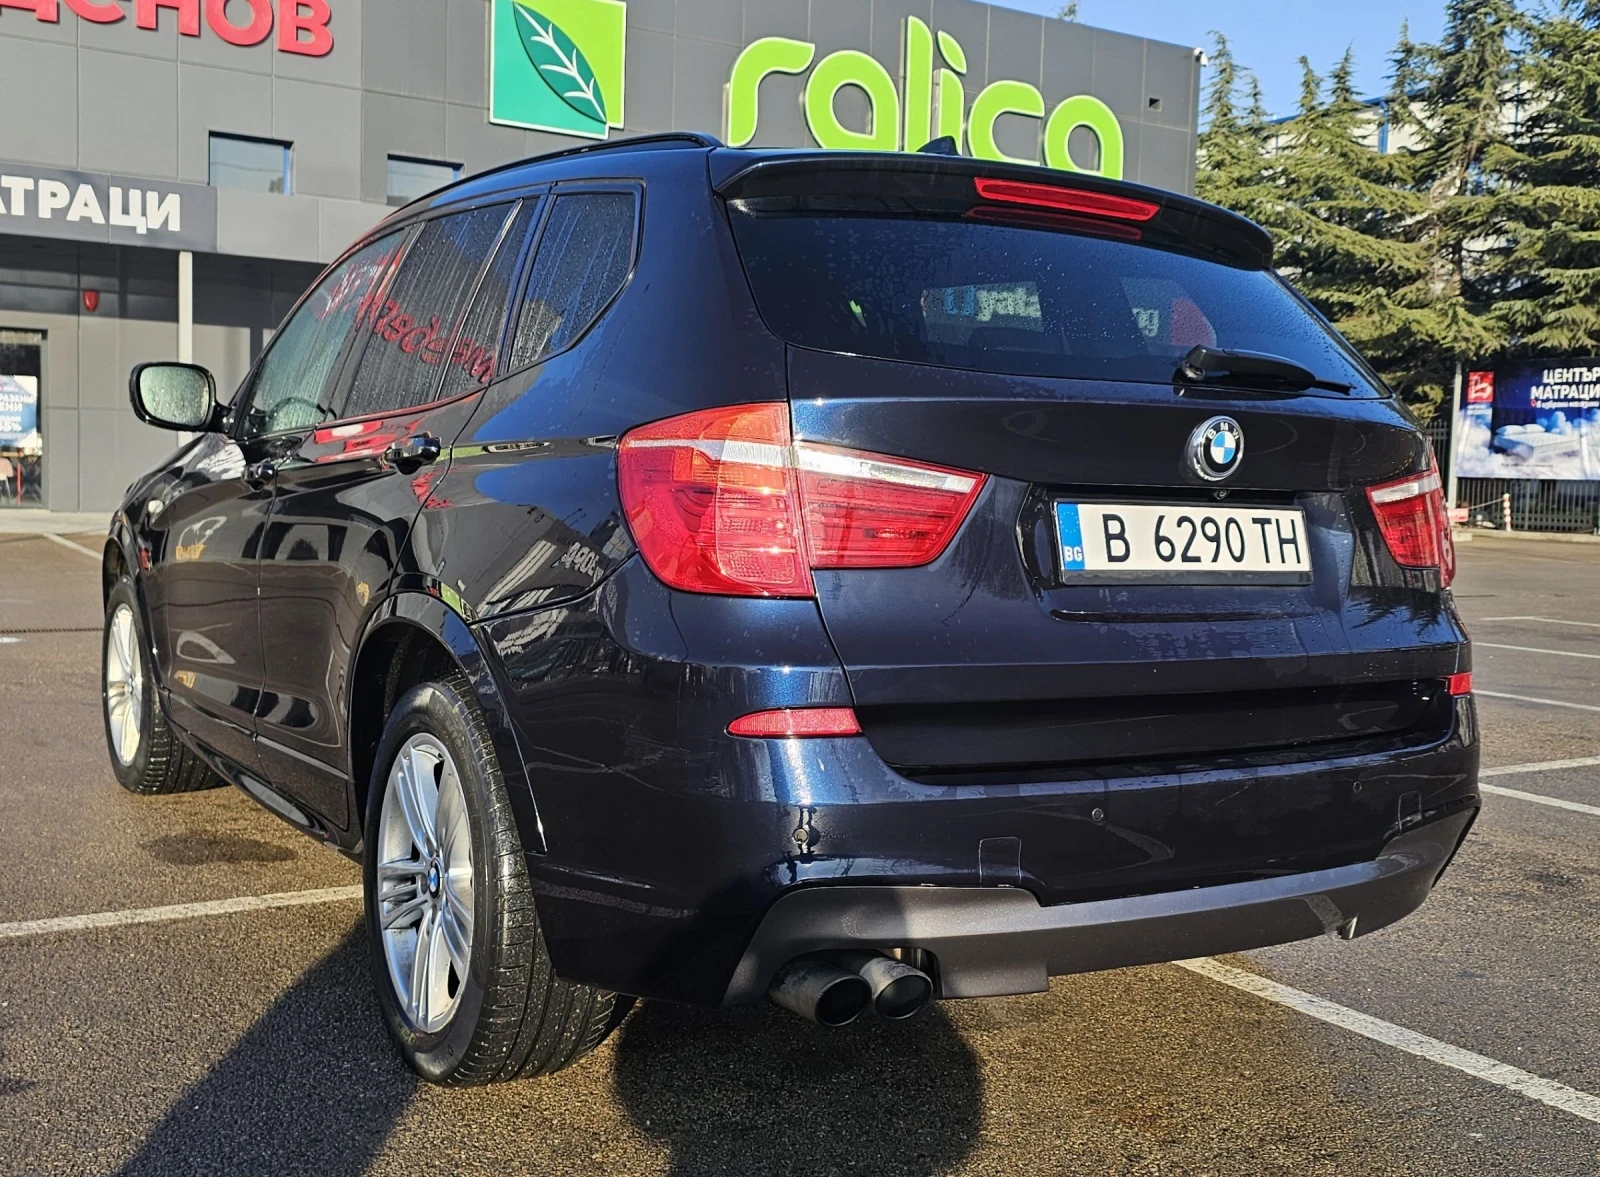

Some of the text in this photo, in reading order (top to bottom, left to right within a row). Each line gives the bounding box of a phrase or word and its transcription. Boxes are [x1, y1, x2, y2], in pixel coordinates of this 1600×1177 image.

[0, 0, 334, 56] НОВ
[727, 15, 1124, 180] ralica
[1542, 366, 1600, 385] ЦЕНТЪР
[1530, 383, 1600, 401] МАТРАЦИ
[1207, 422, 1240, 440] BMW
[1102, 514, 1301, 564] B 6290 TH
[1063, 546, 1083, 562] BG
